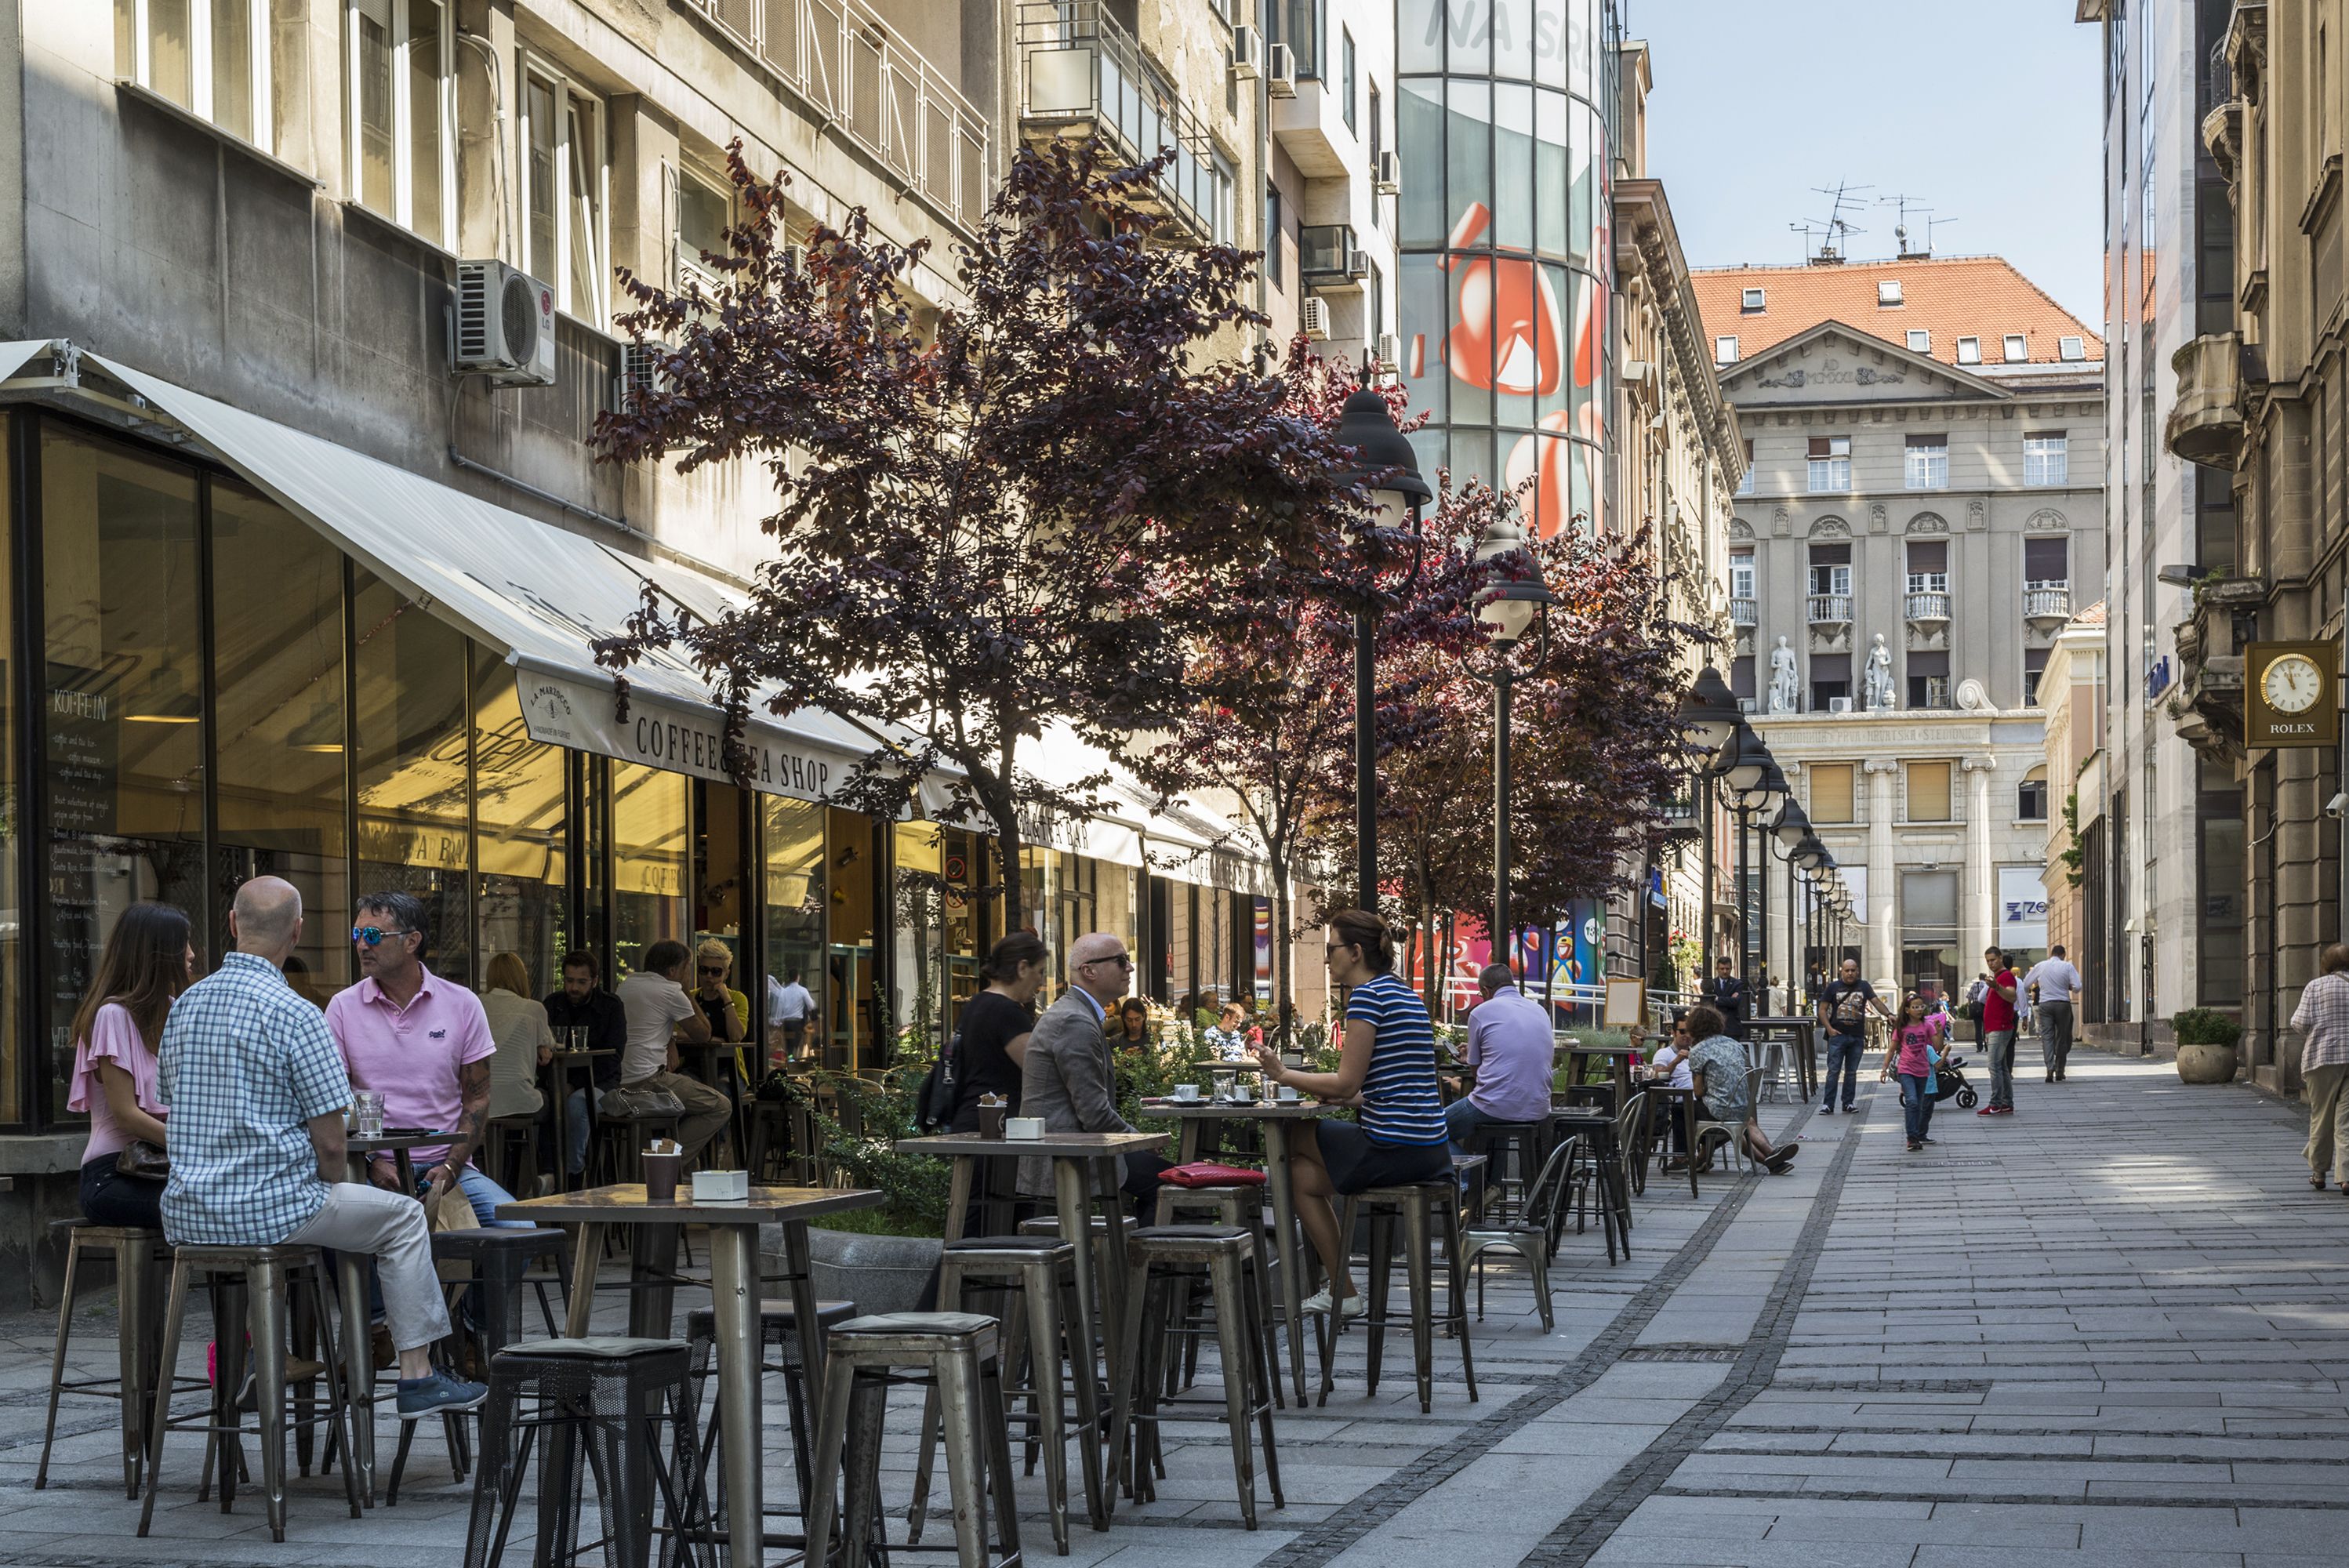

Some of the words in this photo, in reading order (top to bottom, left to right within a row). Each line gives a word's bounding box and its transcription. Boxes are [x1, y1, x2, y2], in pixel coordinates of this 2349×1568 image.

[1425, 0, 1512, 52] NA
[542, 317, 550, 330] LG
[54, 689, 107, 721] KOFFEIN
[531, 693, 539, 707] LA
[539, 686, 572, 715] MARZOCCO
[2271, 724, 2315, 734] ROLEX
[781, 753, 827, 793] SHOP
[1066, 819, 1088, 850] BAR
